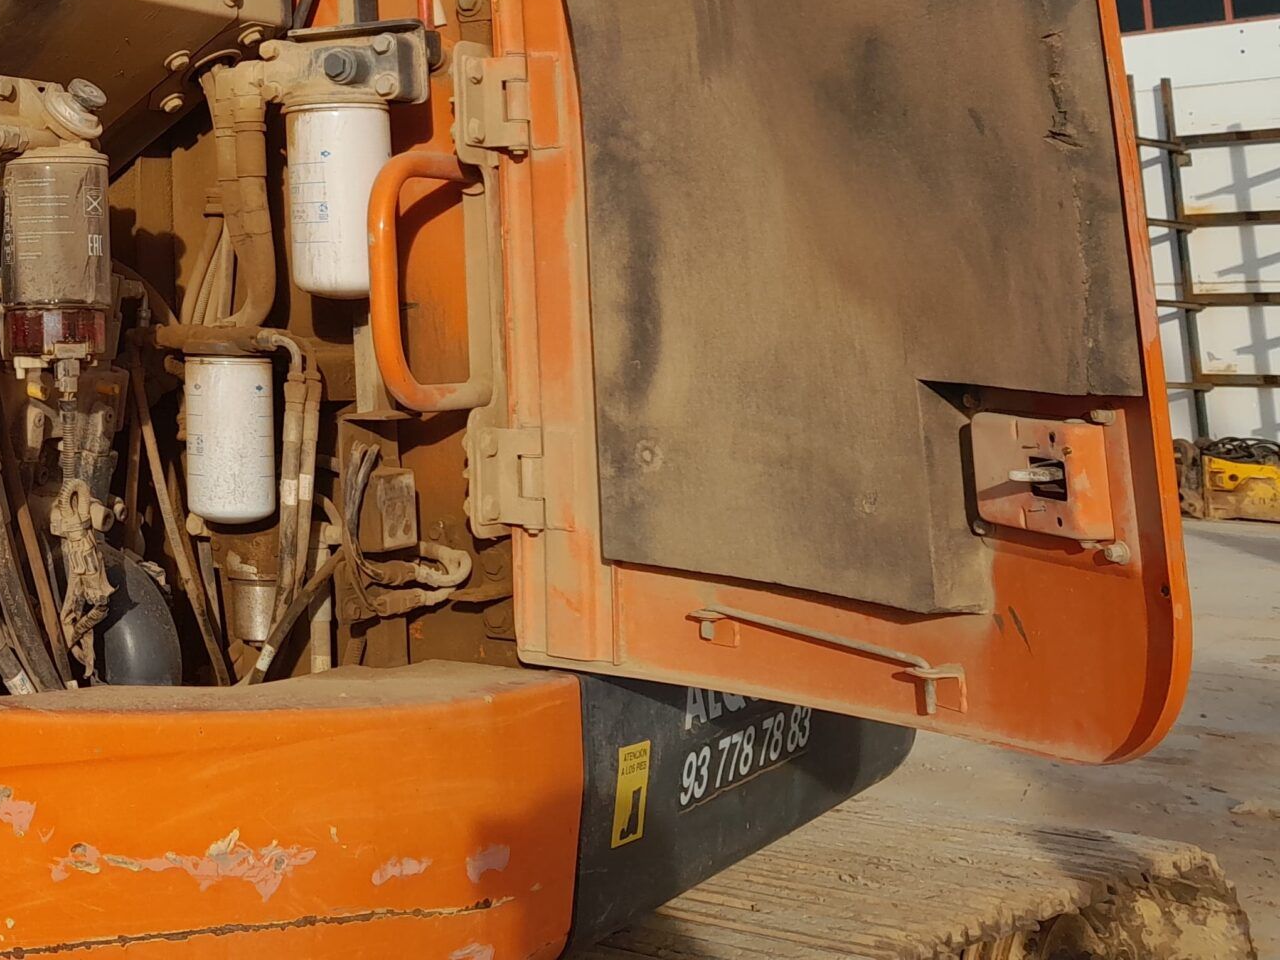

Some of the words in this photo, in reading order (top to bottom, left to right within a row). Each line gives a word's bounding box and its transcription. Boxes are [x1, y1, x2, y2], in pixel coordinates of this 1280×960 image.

[680, 746, 711, 806] 93
[715, 725, 756, 789] 778
[759, 712, 785, 767] 78
[786, 705, 813, 753] 83
